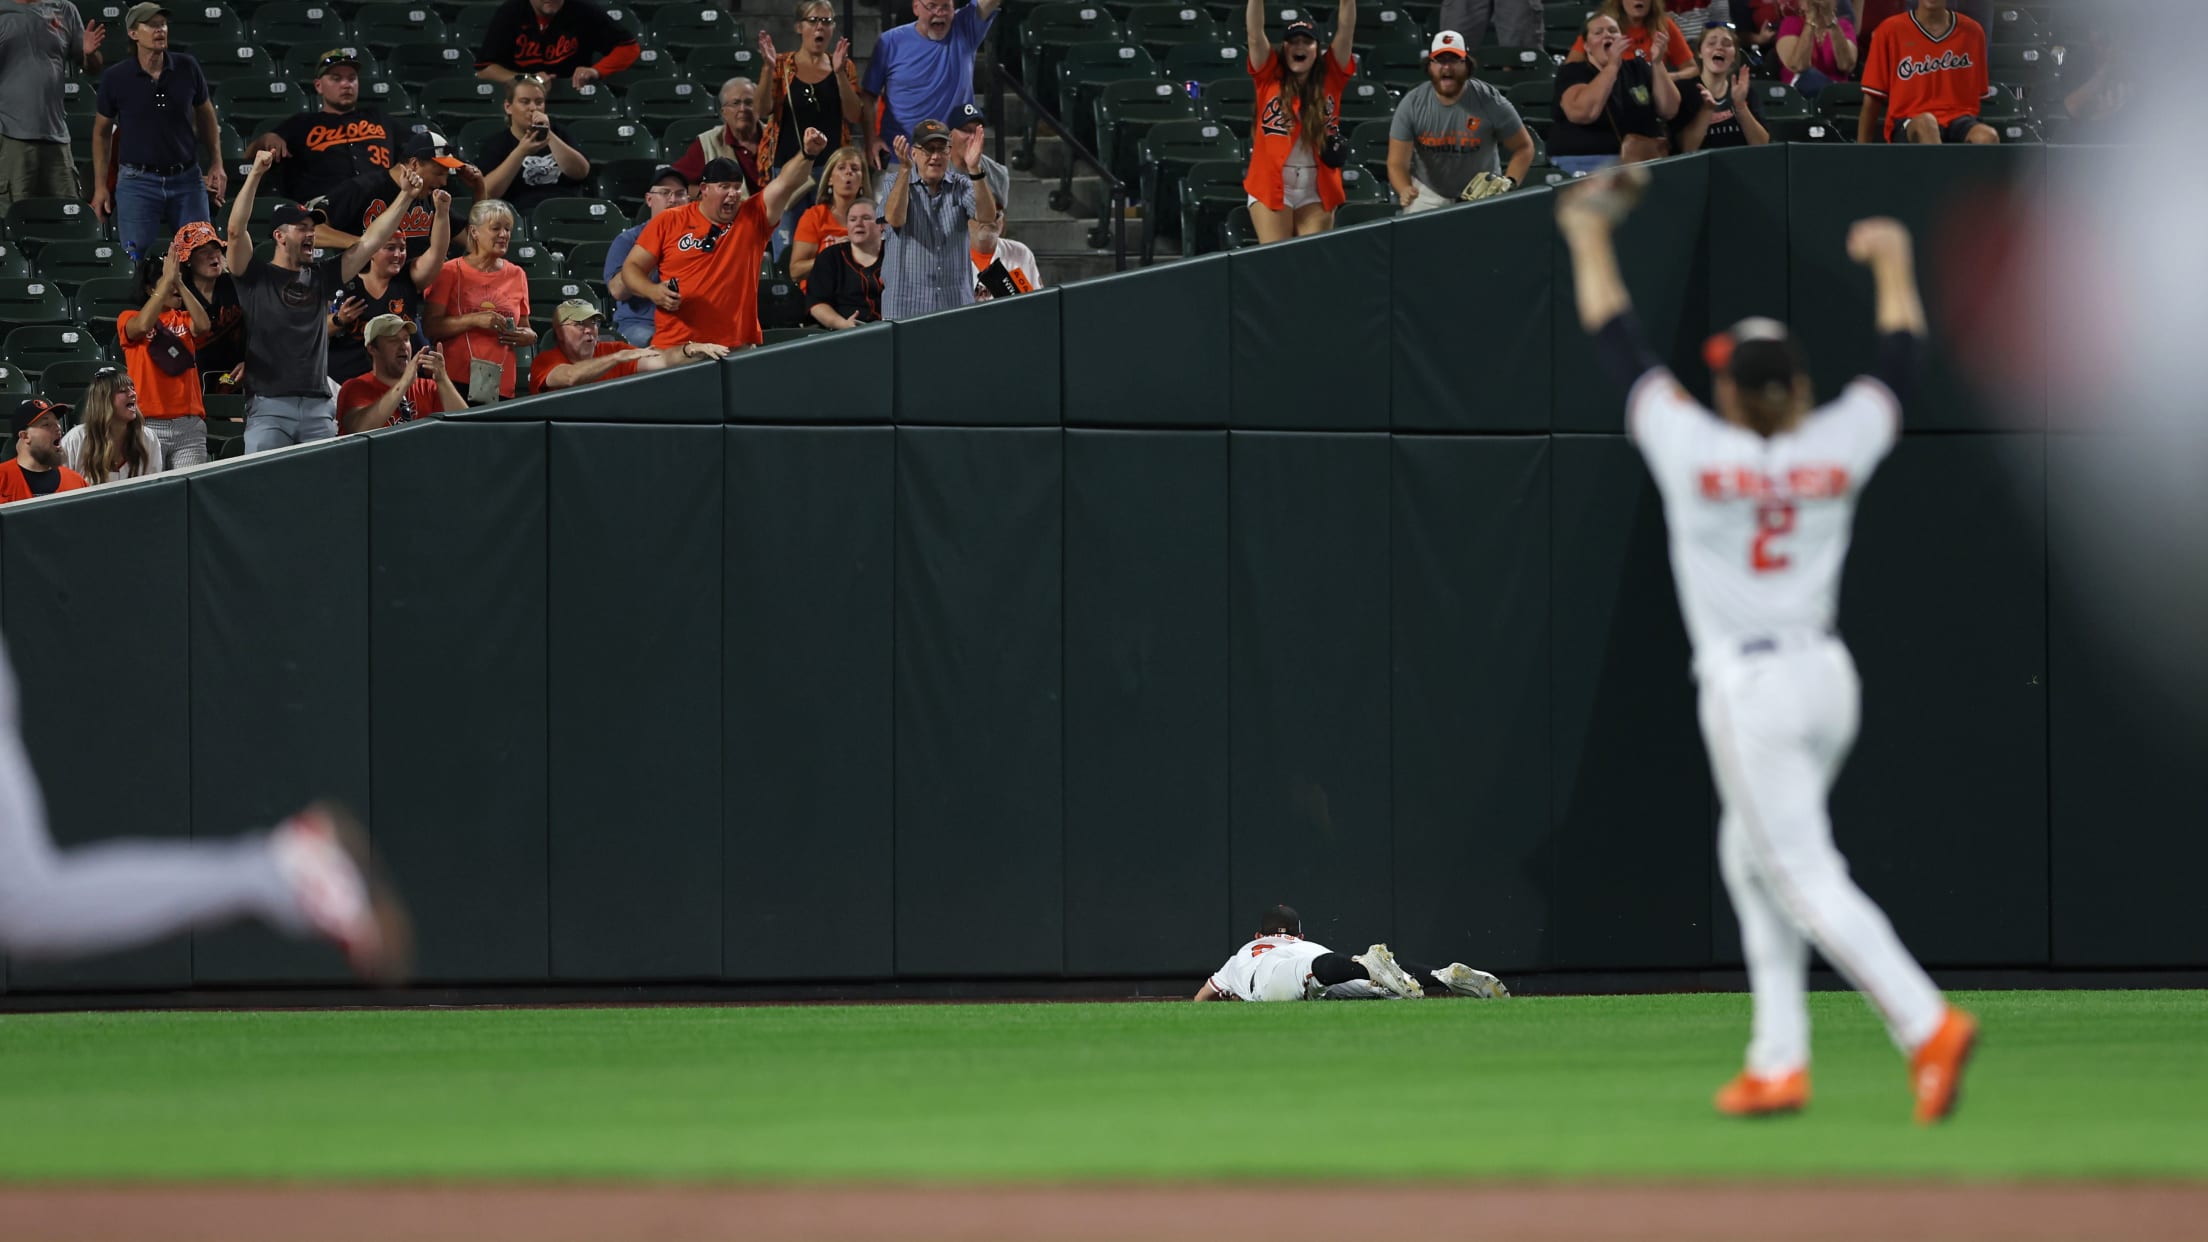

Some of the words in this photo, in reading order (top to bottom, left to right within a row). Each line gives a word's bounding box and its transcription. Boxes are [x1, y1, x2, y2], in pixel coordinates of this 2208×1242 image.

[1897, 50, 1974, 80] Orioles
[305, 118, 388, 151] Orioles
[367, 144, 391, 169] 35
[1752, 503, 1797, 573] 2
